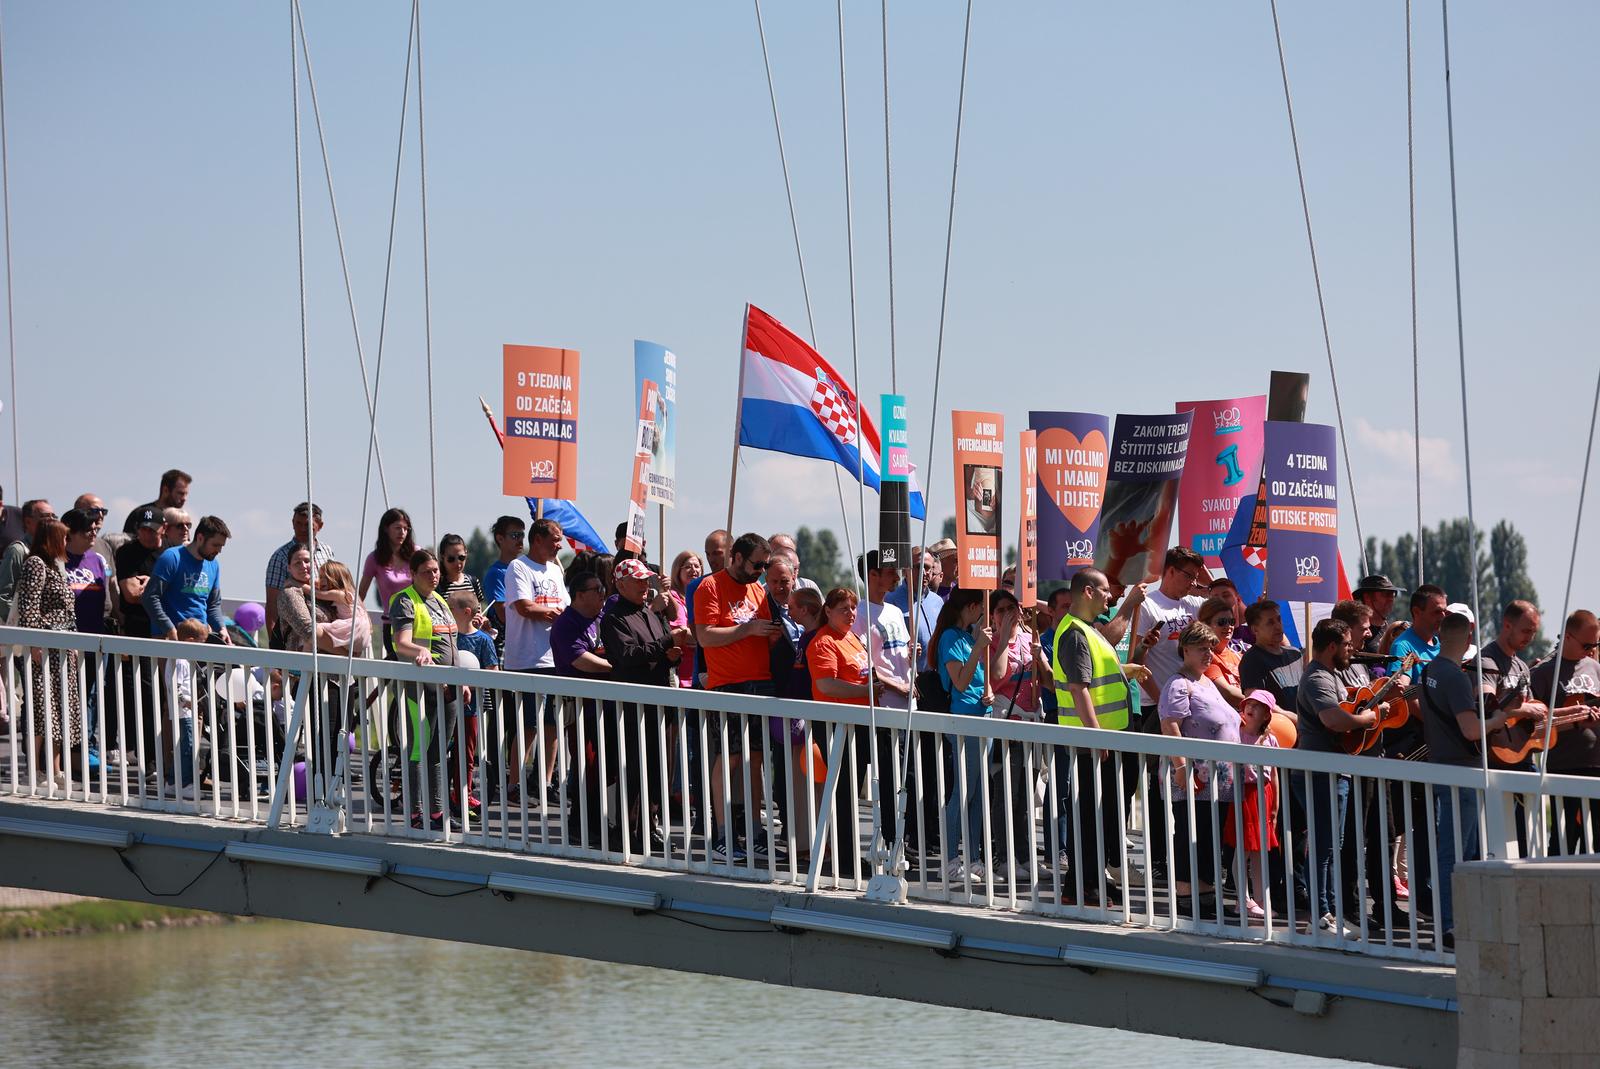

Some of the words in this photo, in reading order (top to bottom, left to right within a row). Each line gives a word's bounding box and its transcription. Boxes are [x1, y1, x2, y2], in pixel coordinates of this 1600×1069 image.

[517, 371, 526, 387] 9
[528, 372, 572, 391] TJEDANA
[516, 395, 533, 411] OD
[534, 394, 572, 415] ZAČEĆA
[1212, 407, 1241, 422] HOD
[514, 419, 540, 436] SISA
[542, 421, 573, 439] PALAC
[1132, 424, 1166, 437] ZAKON
[1167, 422, 1189, 436] TREBA
[1119, 439, 1156, 455] ŠTITITI
[1156, 442, 1173, 455] SVE
[530, 459, 554, 473] HOD
[1045, 448, 1062, 465] MI
[1065, 448, 1104, 468] VOLIMO
[1286, 453, 1294, 469] 4
[1295, 453, 1328, 471] TJEDNA
[1113, 460, 1136, 473] BEZ
[1056, 469, 1061, 485] I
[1064, 469, 1099, 487] MAMU
[1271, 480, 1287, 497] OD
[1288, 479, 1323, 499] ZAČEĆA
[1324, 484, 1337, 501] IMA
[1056, 490, 1061, 506] I
[1064, 490, 1100, 508] DIJETE
[1202, 497, 1230, 512] SVAKO
[1208, 517, 1226, 531] IMA
[1271, 509, 1307, 526] OTISKE
[1065, 538, 1093, 553] HOD
[1201, 537, 1215, 551] NA
[1294, 555, 1320, 570] HOD
